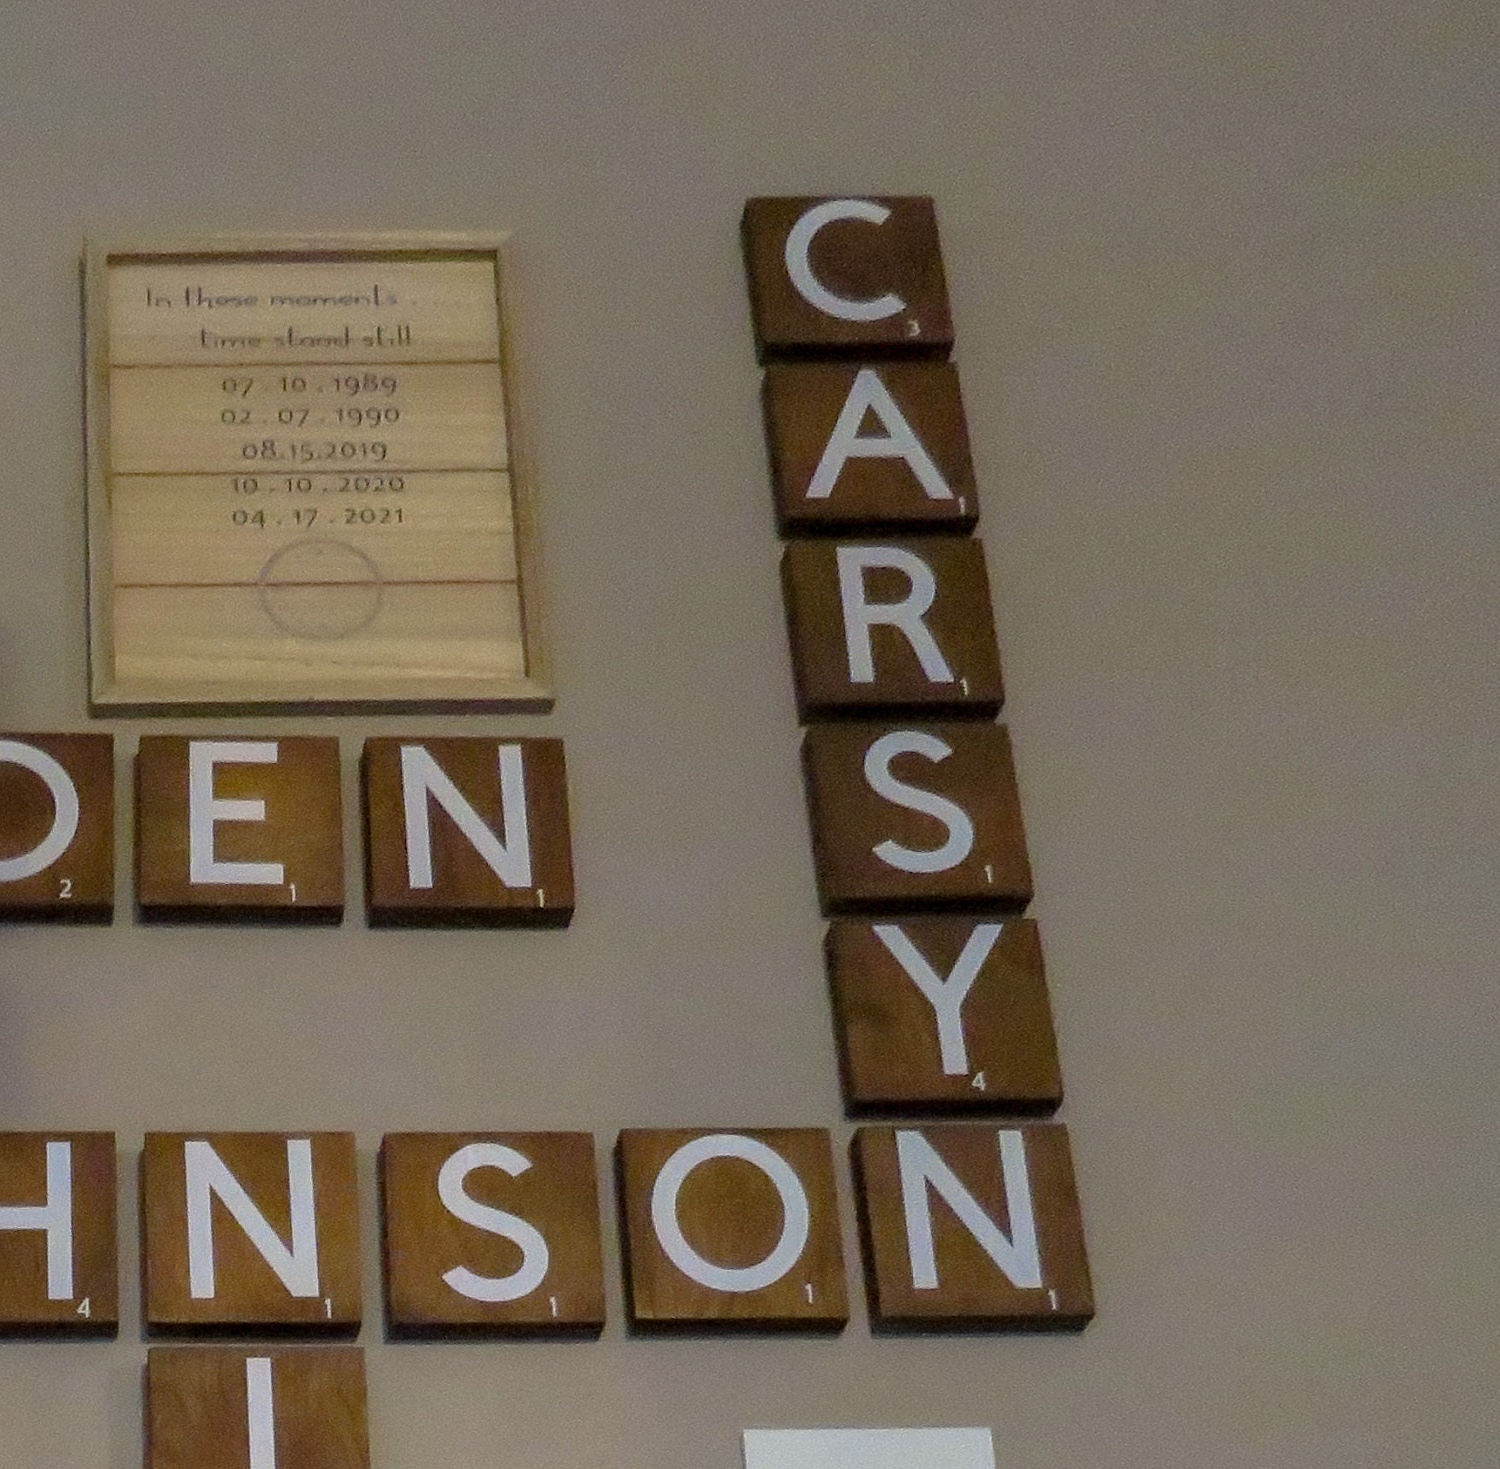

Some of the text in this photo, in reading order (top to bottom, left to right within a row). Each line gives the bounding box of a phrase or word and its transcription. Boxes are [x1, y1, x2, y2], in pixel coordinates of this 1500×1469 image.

[59, 879, 72, 898] 2
[971, 1071, 986, 1091] 4
[76, 1297, 90, 1318] 4
